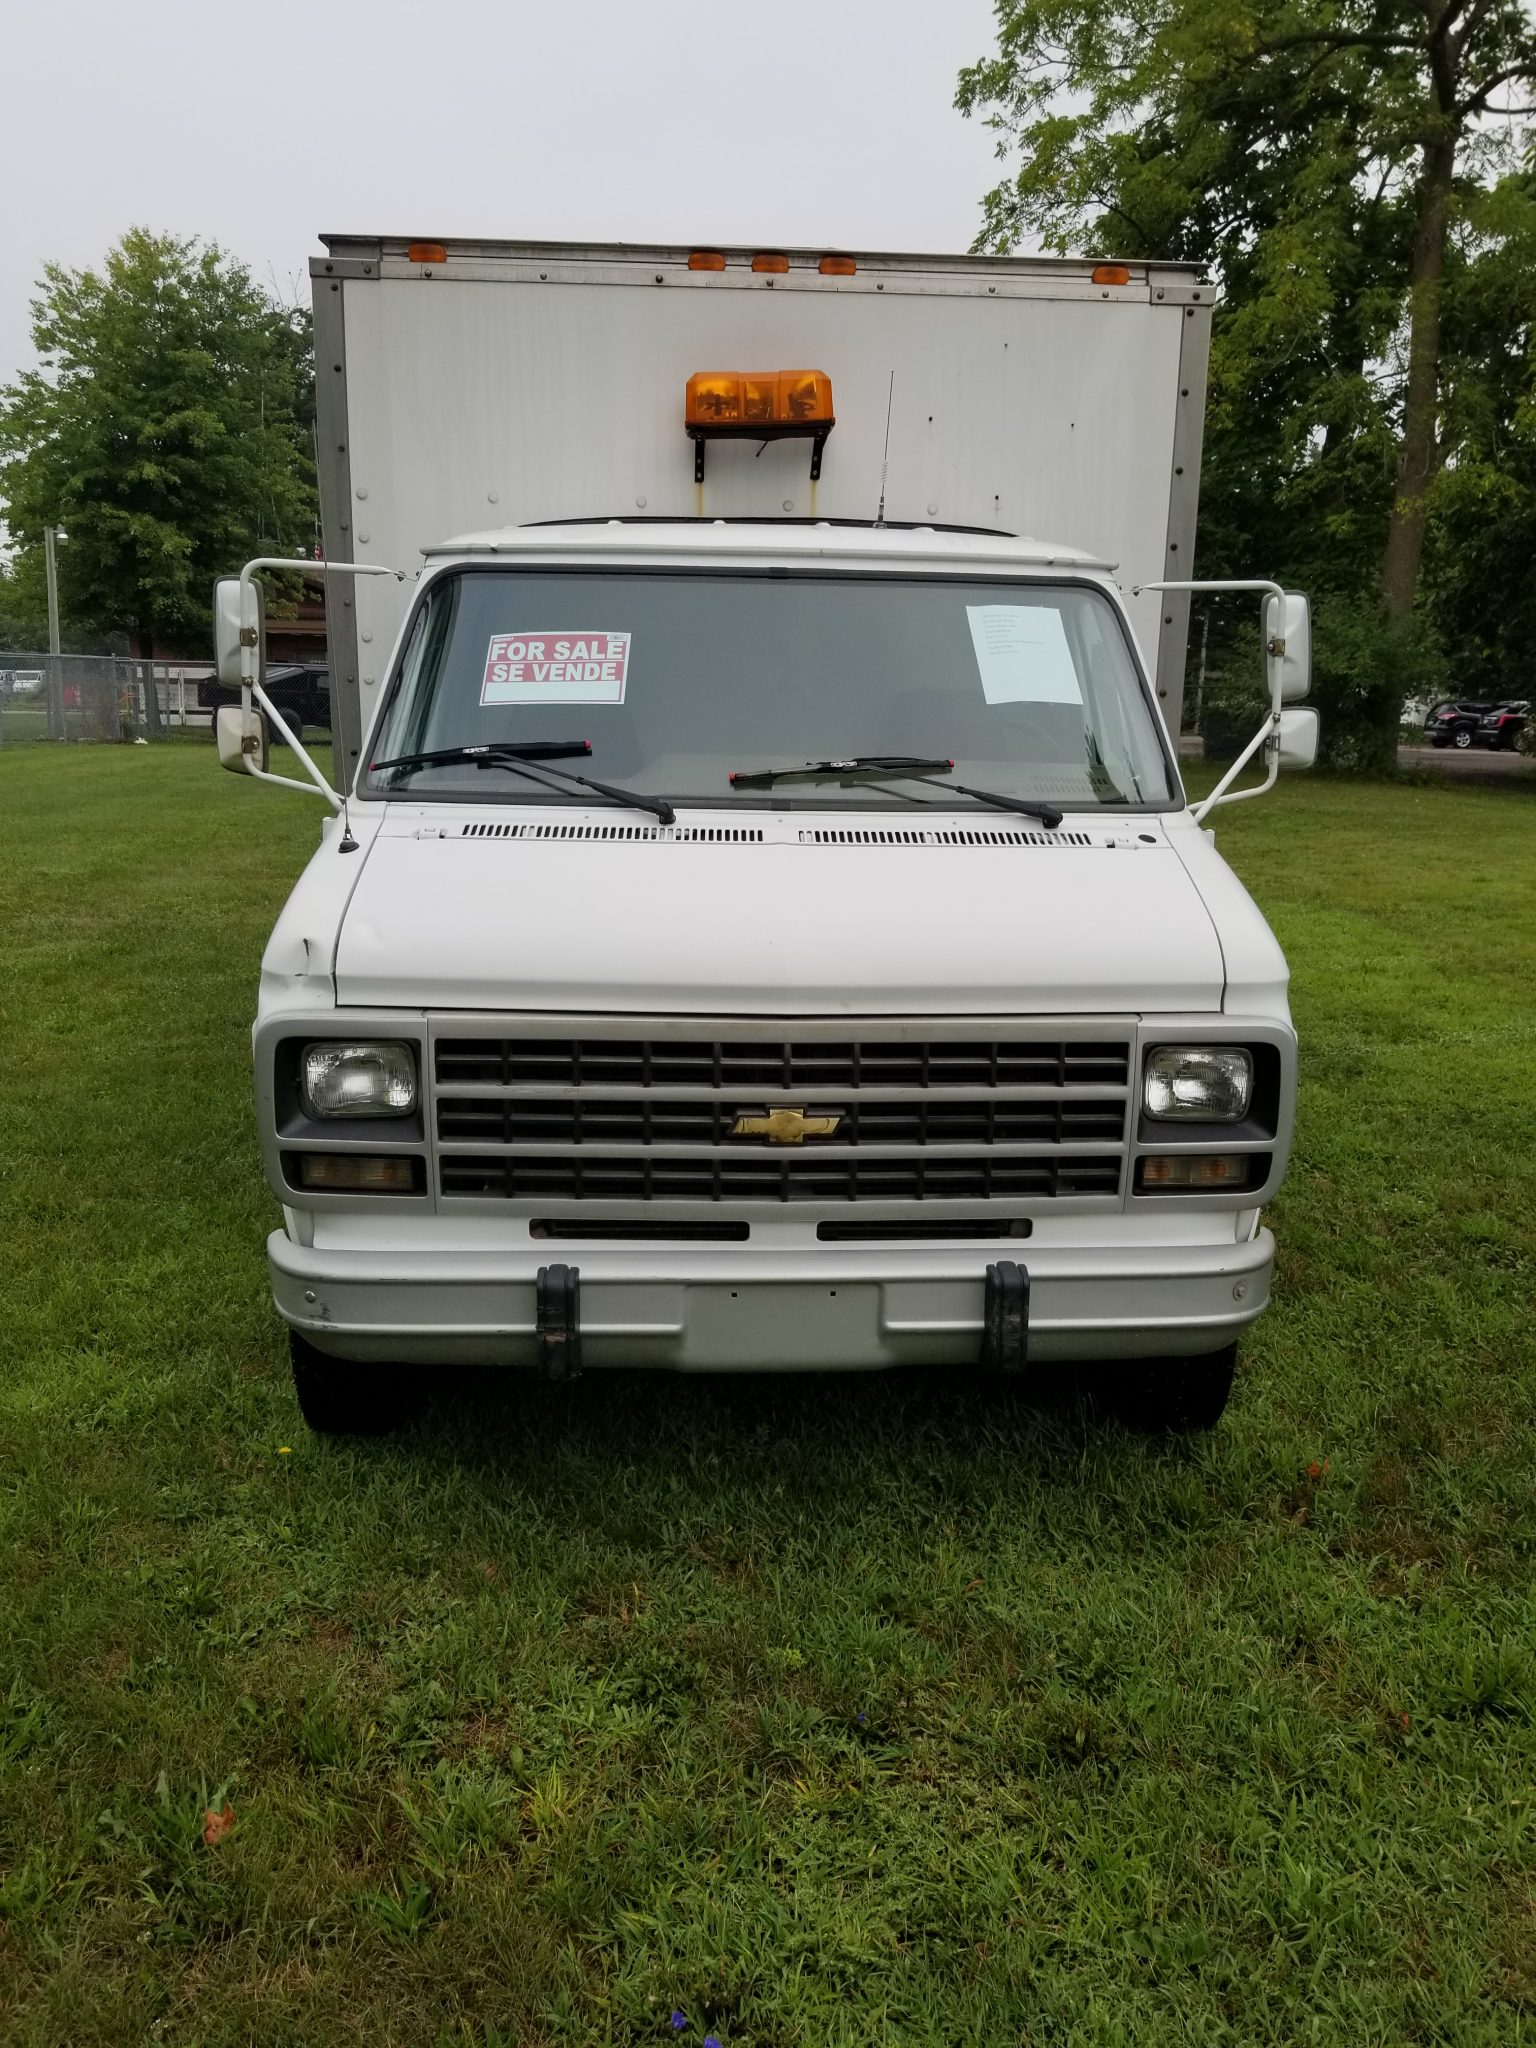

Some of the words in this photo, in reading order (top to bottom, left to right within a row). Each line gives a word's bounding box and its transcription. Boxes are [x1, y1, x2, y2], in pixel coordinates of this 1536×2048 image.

[491, 641, 545, 661] FOR
[553, 641, 624, 660] SALE
[492, 663, 525, 682] SE
[532, 662, 617, 681] VENDE
